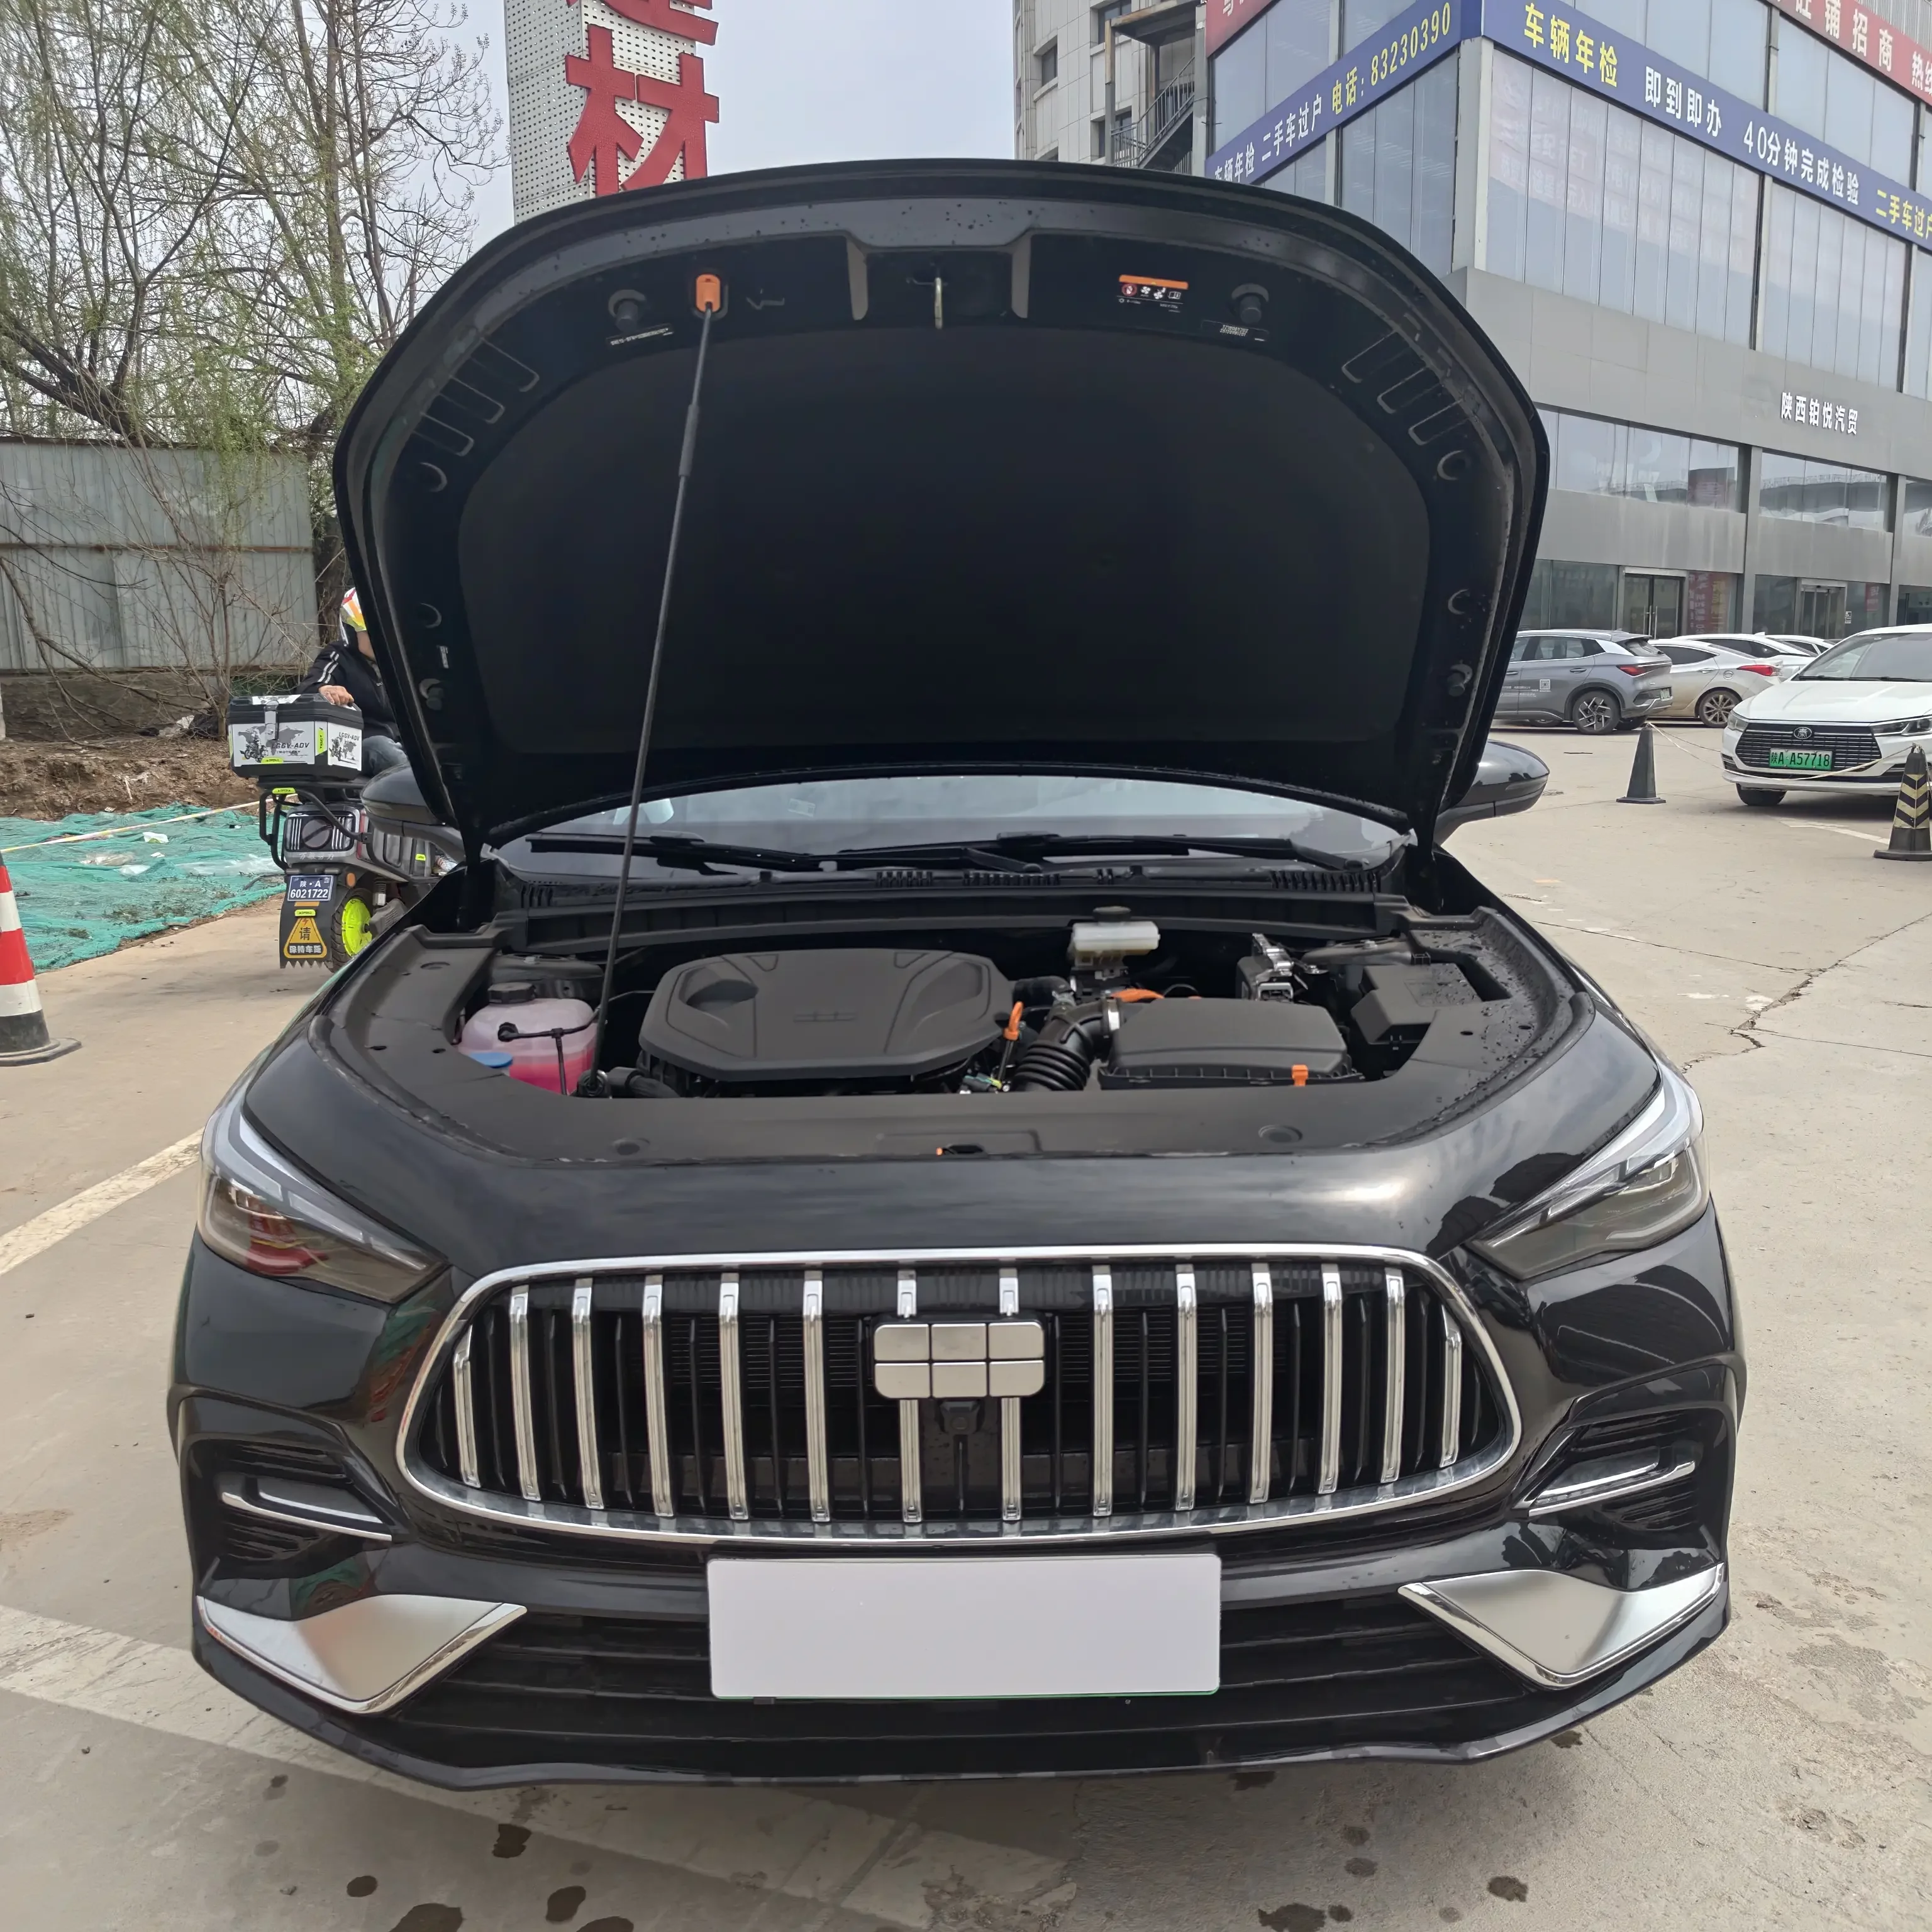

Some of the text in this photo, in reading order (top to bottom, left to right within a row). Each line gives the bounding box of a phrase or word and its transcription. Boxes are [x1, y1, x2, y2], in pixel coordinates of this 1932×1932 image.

[565, 0, 719, 196] 材
[1262, 93, 1322, 162] 二手车过户
[1523, 3, 1618, 87] 车辆年检
[1645, 66, 1721, 137] 即到即办
[1743, 120, 1859, 206] 40分钟完成检验
[1875, 189, 1932, 240] 二手车过户
[1781, 392, 1858, 435] 陕西铂悦汽贸
[290, 889, 328, 898] 6021722
[289, 945, 321, 954] 保持车距
[299, 927, 311, 941] 请
